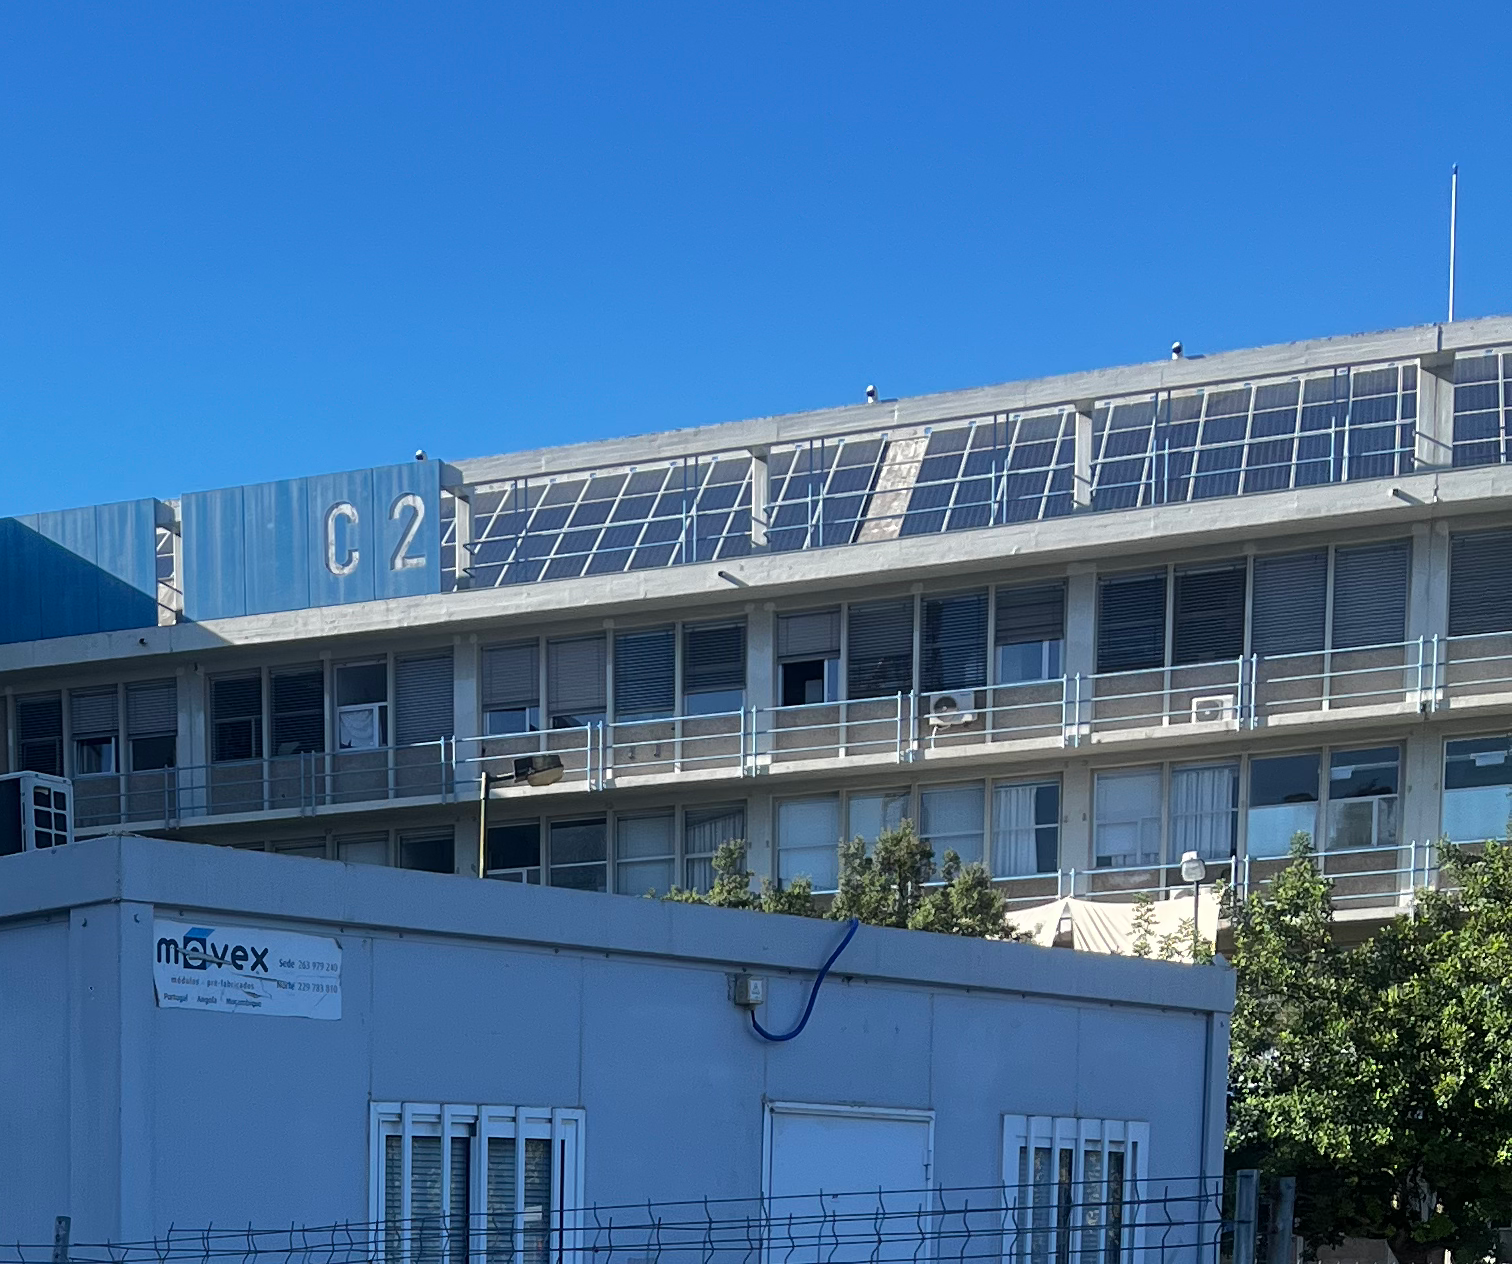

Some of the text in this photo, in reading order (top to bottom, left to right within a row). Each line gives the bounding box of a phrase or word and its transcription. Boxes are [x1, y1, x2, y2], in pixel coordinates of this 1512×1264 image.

[156, 937, 269, 973] movex
[278, 958, 295, 969] Sede
[298, 960, 311, 970] 263
[312, 961, 325, 971] 979
[297, 982, 311, 992] 229
